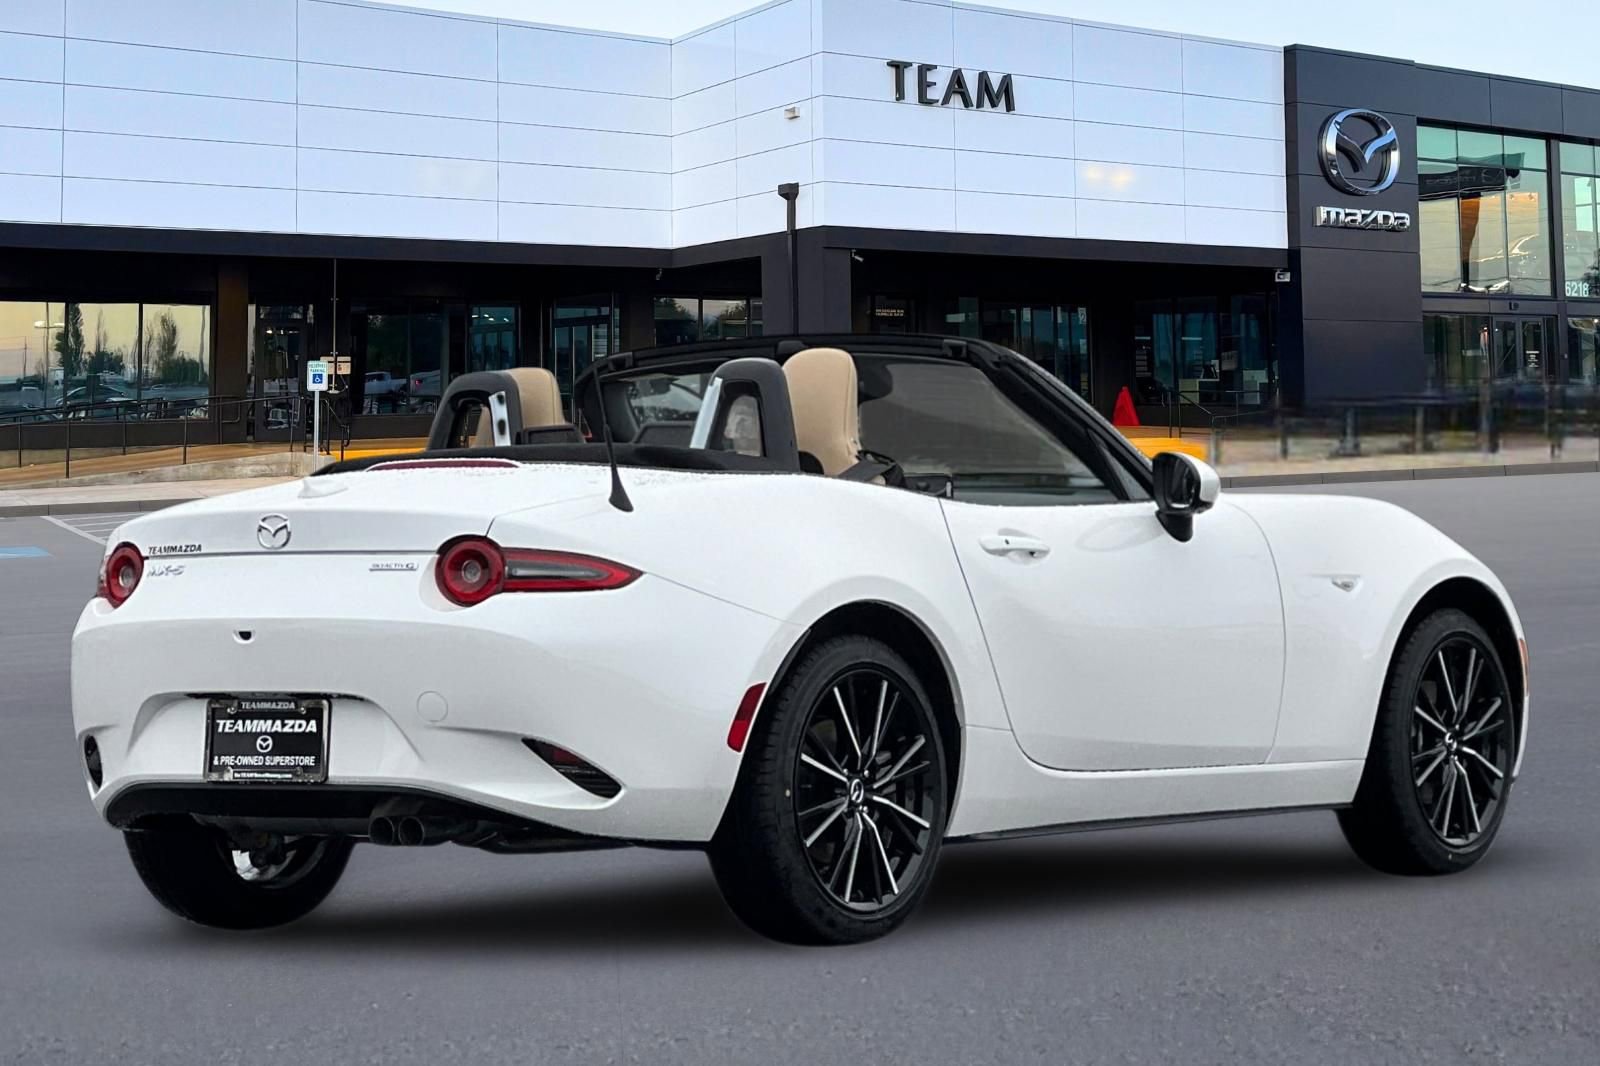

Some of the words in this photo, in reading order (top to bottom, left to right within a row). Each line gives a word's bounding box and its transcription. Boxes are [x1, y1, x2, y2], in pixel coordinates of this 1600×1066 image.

[887, 60, 1015, 112] TEAM
[1565, 281, 1589, 297] 6218
[148, 544, 202, 555] TEAMMAZDA
[241, 701, 296, 710] TEAMMAZDA
[216, 719, 318, 733] TEAMMAZDA
[213, 756, 219, 766] &
[220, 755, 264, 766] PRE-OWNED
[265, 755, 316, 766] SUPERSTORE
